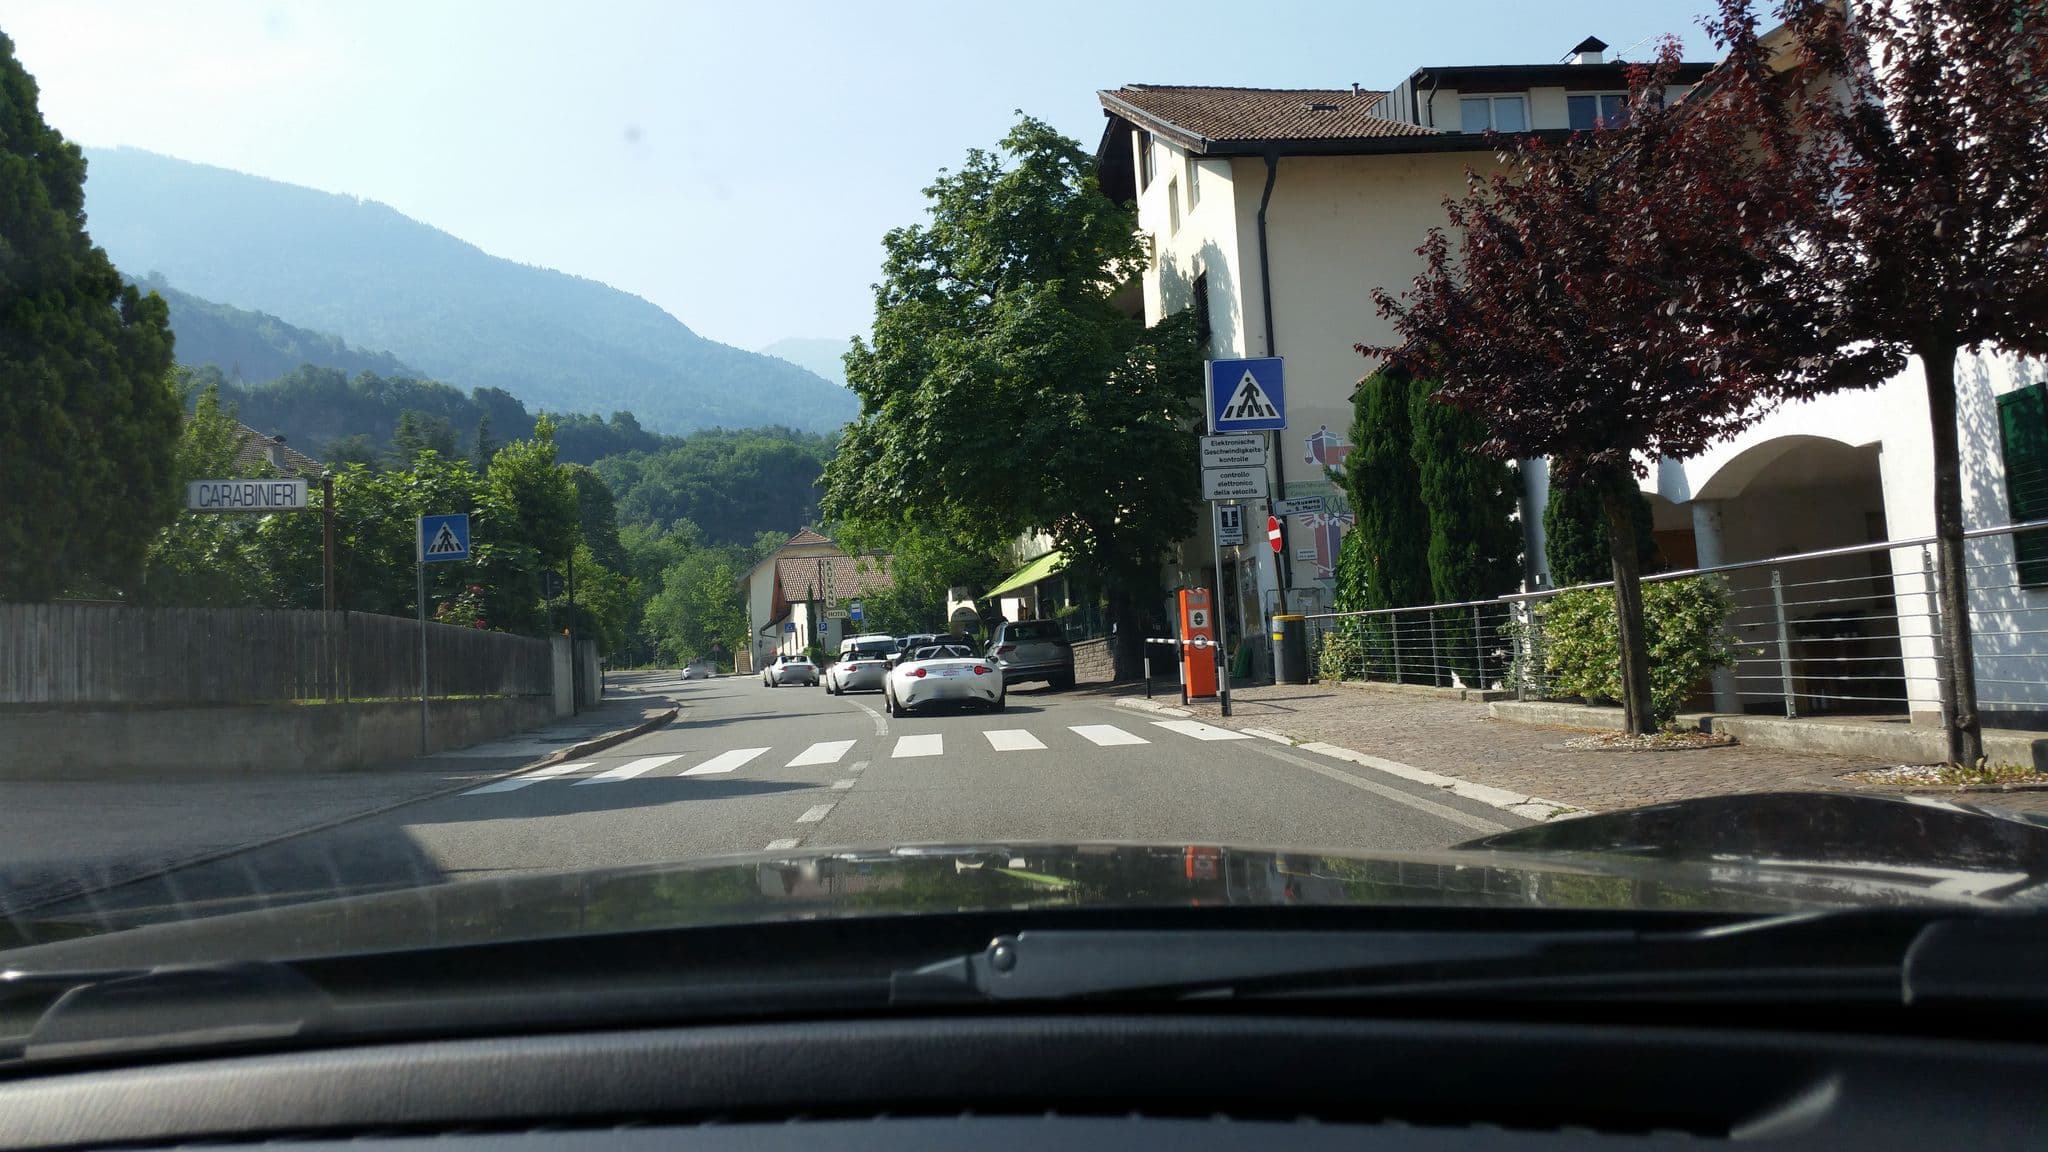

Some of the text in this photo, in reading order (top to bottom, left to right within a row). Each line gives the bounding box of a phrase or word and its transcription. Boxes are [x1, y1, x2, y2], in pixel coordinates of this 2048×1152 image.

[1210, 439, 1256, 447] Elektronische
[199, 483, 297, 507] CARABINIERI
[826, 560, 834, 606] KAUFMANN
